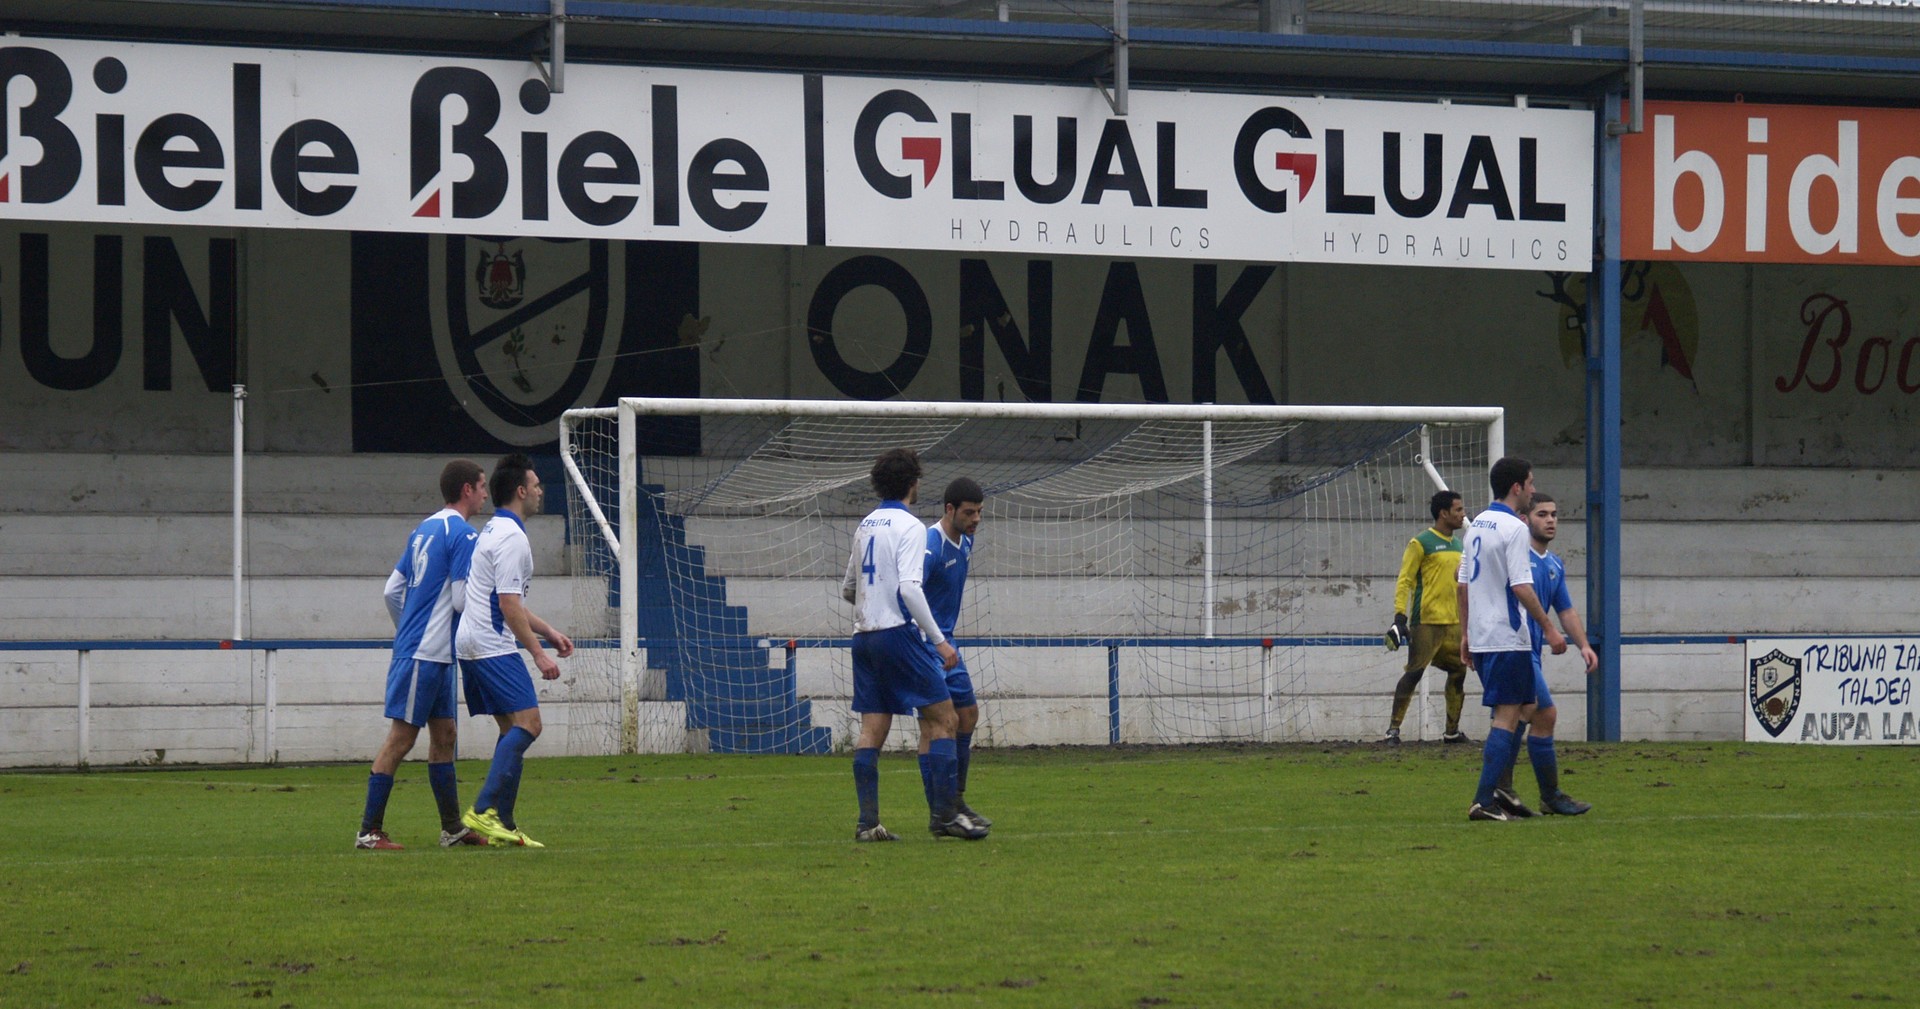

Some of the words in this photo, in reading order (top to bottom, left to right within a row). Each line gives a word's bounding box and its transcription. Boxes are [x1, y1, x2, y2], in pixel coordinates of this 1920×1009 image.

[410, 66, 769, 232] Biele
[853, 89, 1208, 209] GLUAL
[1233, 106, 1566, 222] GLUAL
[1653, 114, 1920, 257] bide
[951, 219, 1210, 249] HYDRAULICS
[1324, 232, 1568, 260] HYDRAULICS
[0, 233, 237, 393] UN
[807, 255, 1277, 404] ONAK
[862, 536, 876, 586] 4
[1470, 536, 1481, 582] 3
[1804, 644, 1886, 672] TRIBUNA
[1894, 644, 1920, 672] ZA
[1838, 677, 1911, 706] TALDEA
[1801, 712, 1872, 741] AUPA
[1883, 712, 1920, 740] LA
